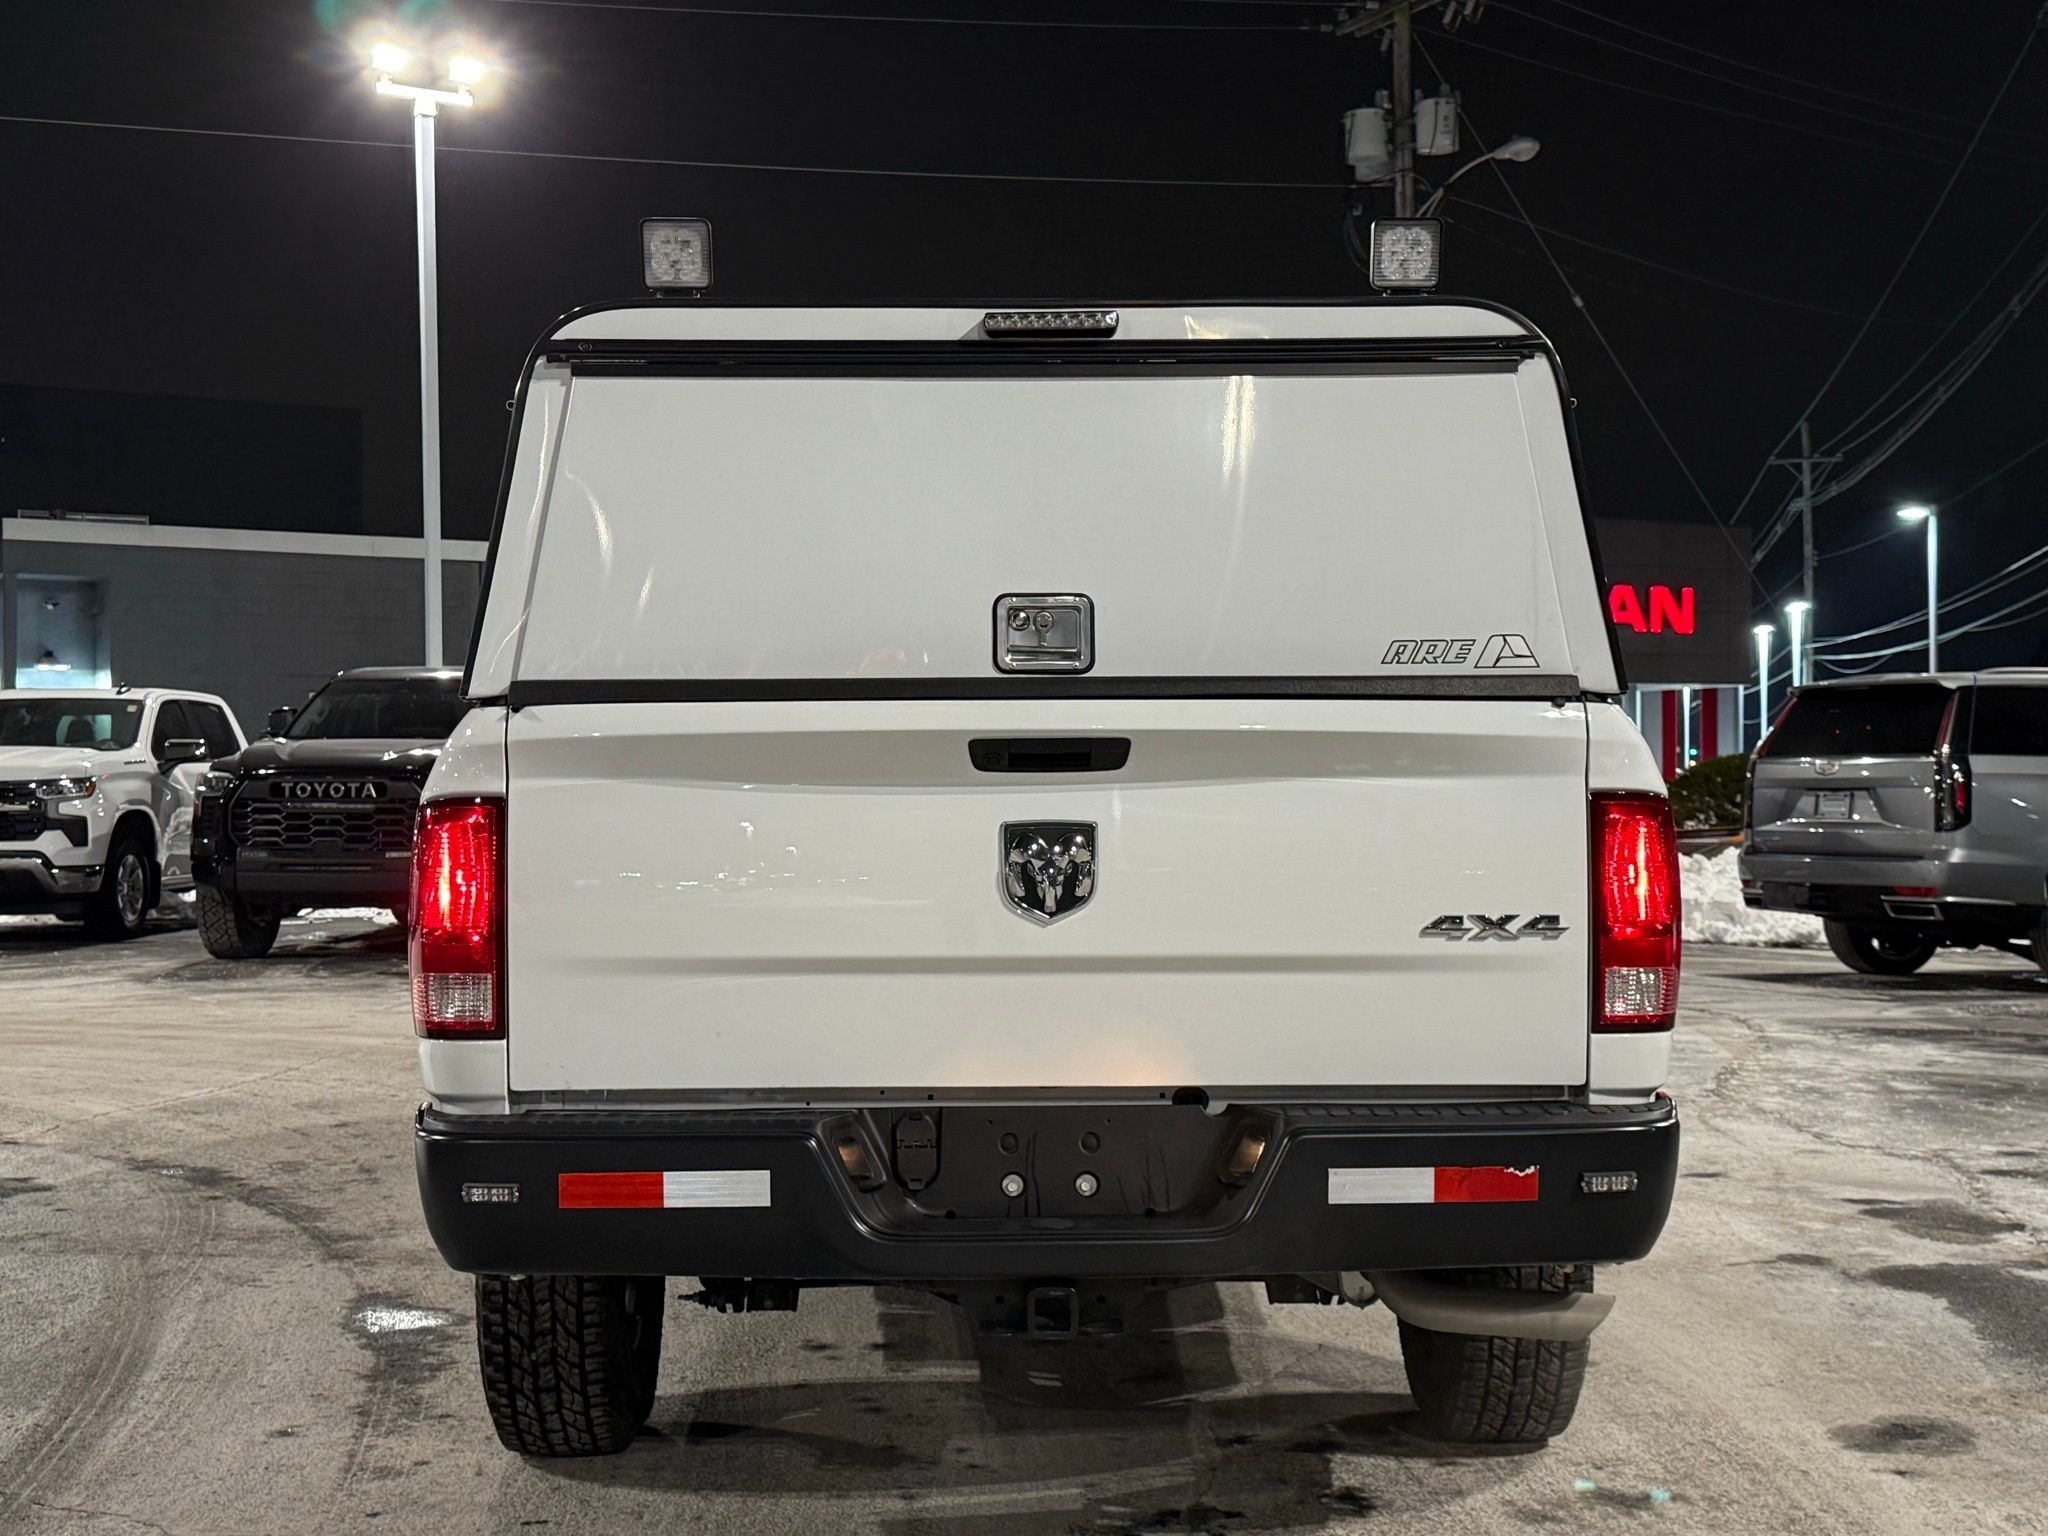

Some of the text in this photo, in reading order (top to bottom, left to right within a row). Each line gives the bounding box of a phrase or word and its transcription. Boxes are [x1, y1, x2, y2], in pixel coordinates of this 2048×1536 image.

[1380, 639, 1477, 665] ARE
[281, 782, 377, 798] TOYOTA
[1418, 914, 1570, 942] 4X4
